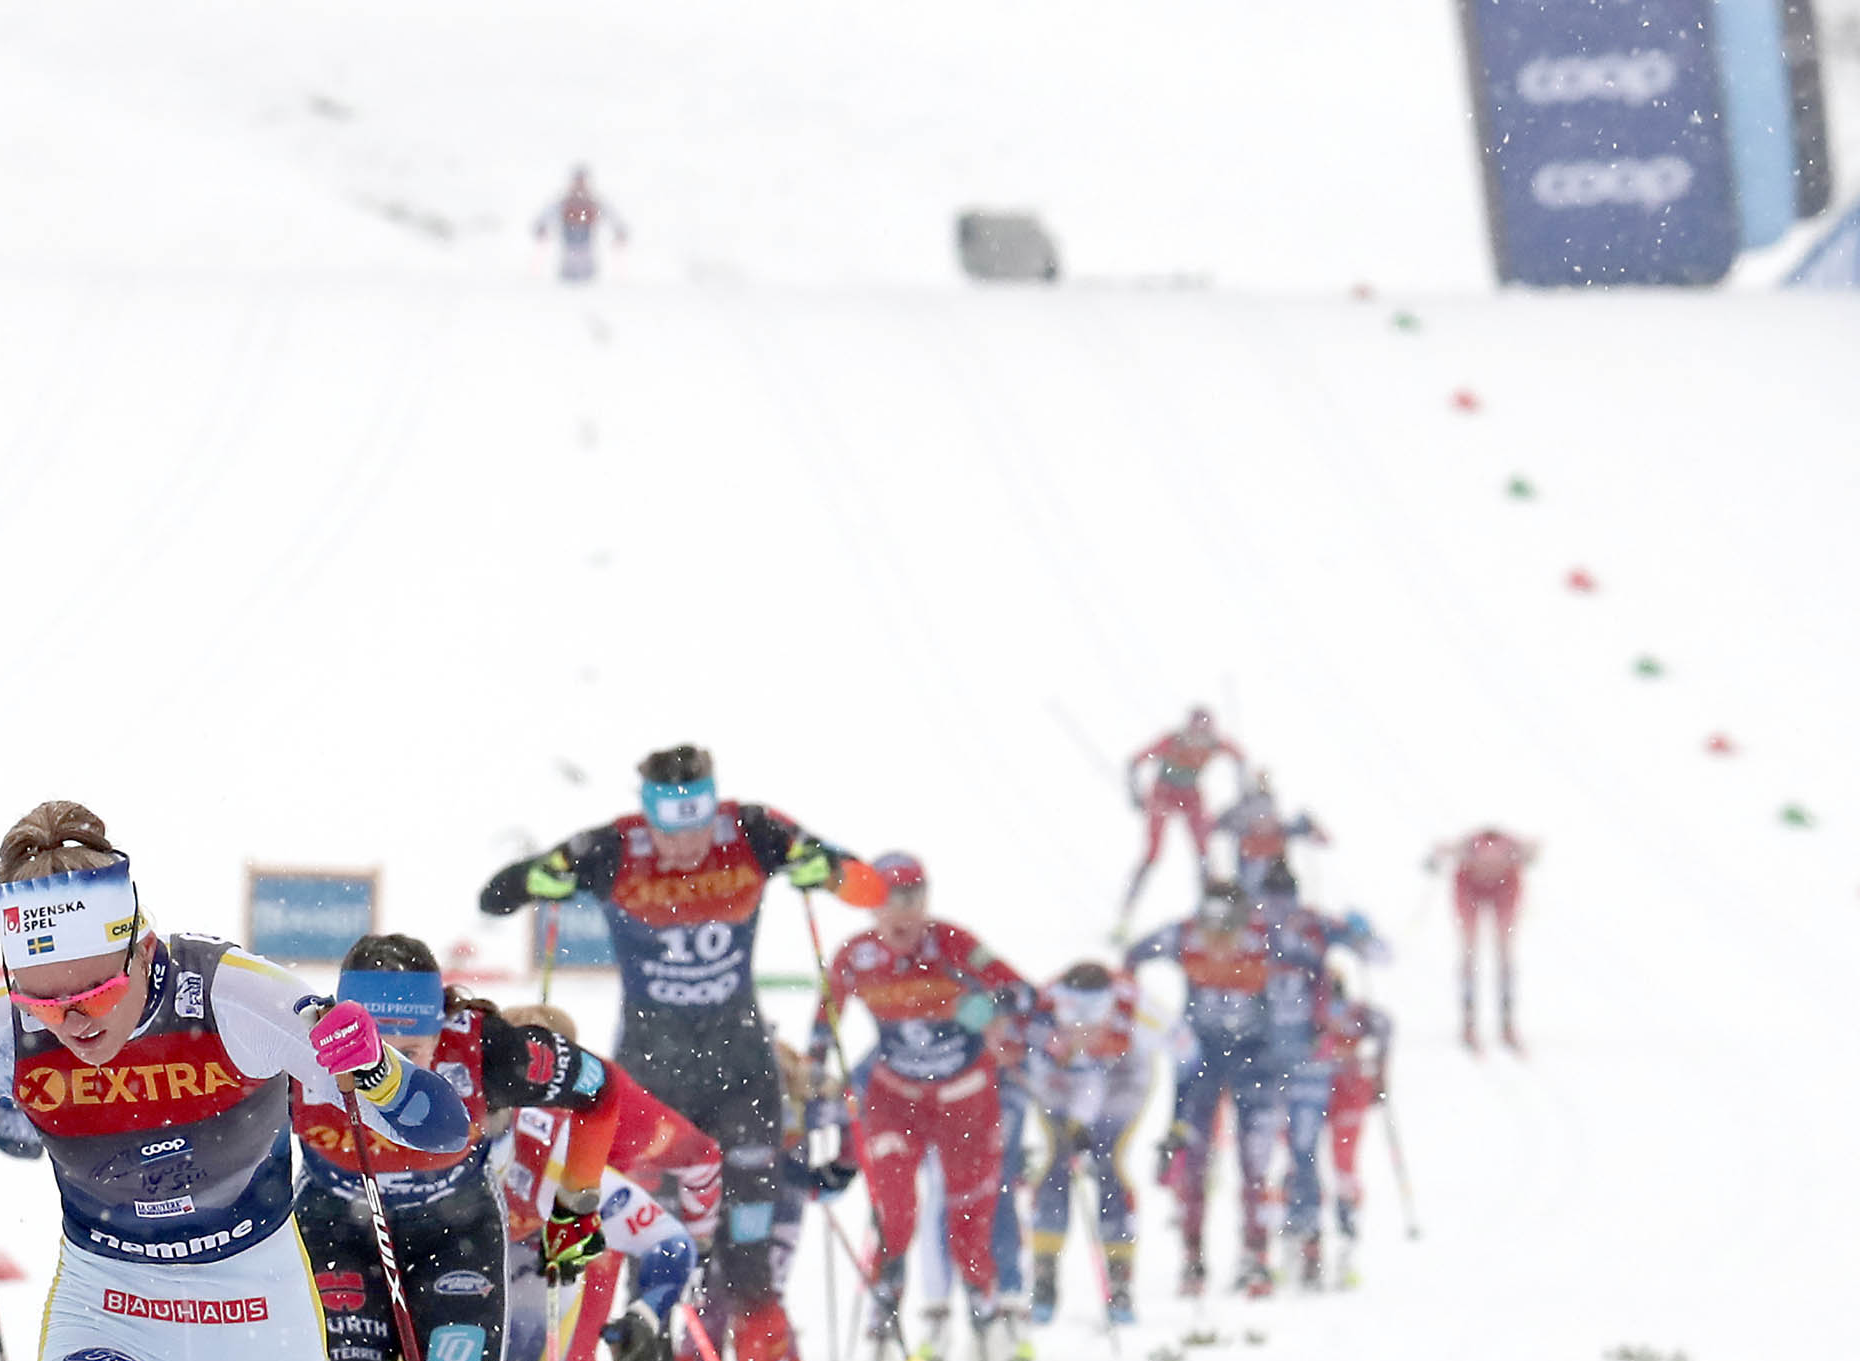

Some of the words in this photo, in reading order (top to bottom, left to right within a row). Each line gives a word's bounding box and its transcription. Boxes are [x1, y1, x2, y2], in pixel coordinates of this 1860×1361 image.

[23, 901, 86, 921] SVENSKA
[24, 917, 57, 932] SPEL
[112, 918, 144, 936] CRA
[657, 922, 732, 962] 10
[72, 1061, 242, 1105] EXTRA
[141, 1138, 186, 1156] coop
[361, 1172, 408, 1313] SWIX
[106, 1292, 267, 1321] BAUHAUS
